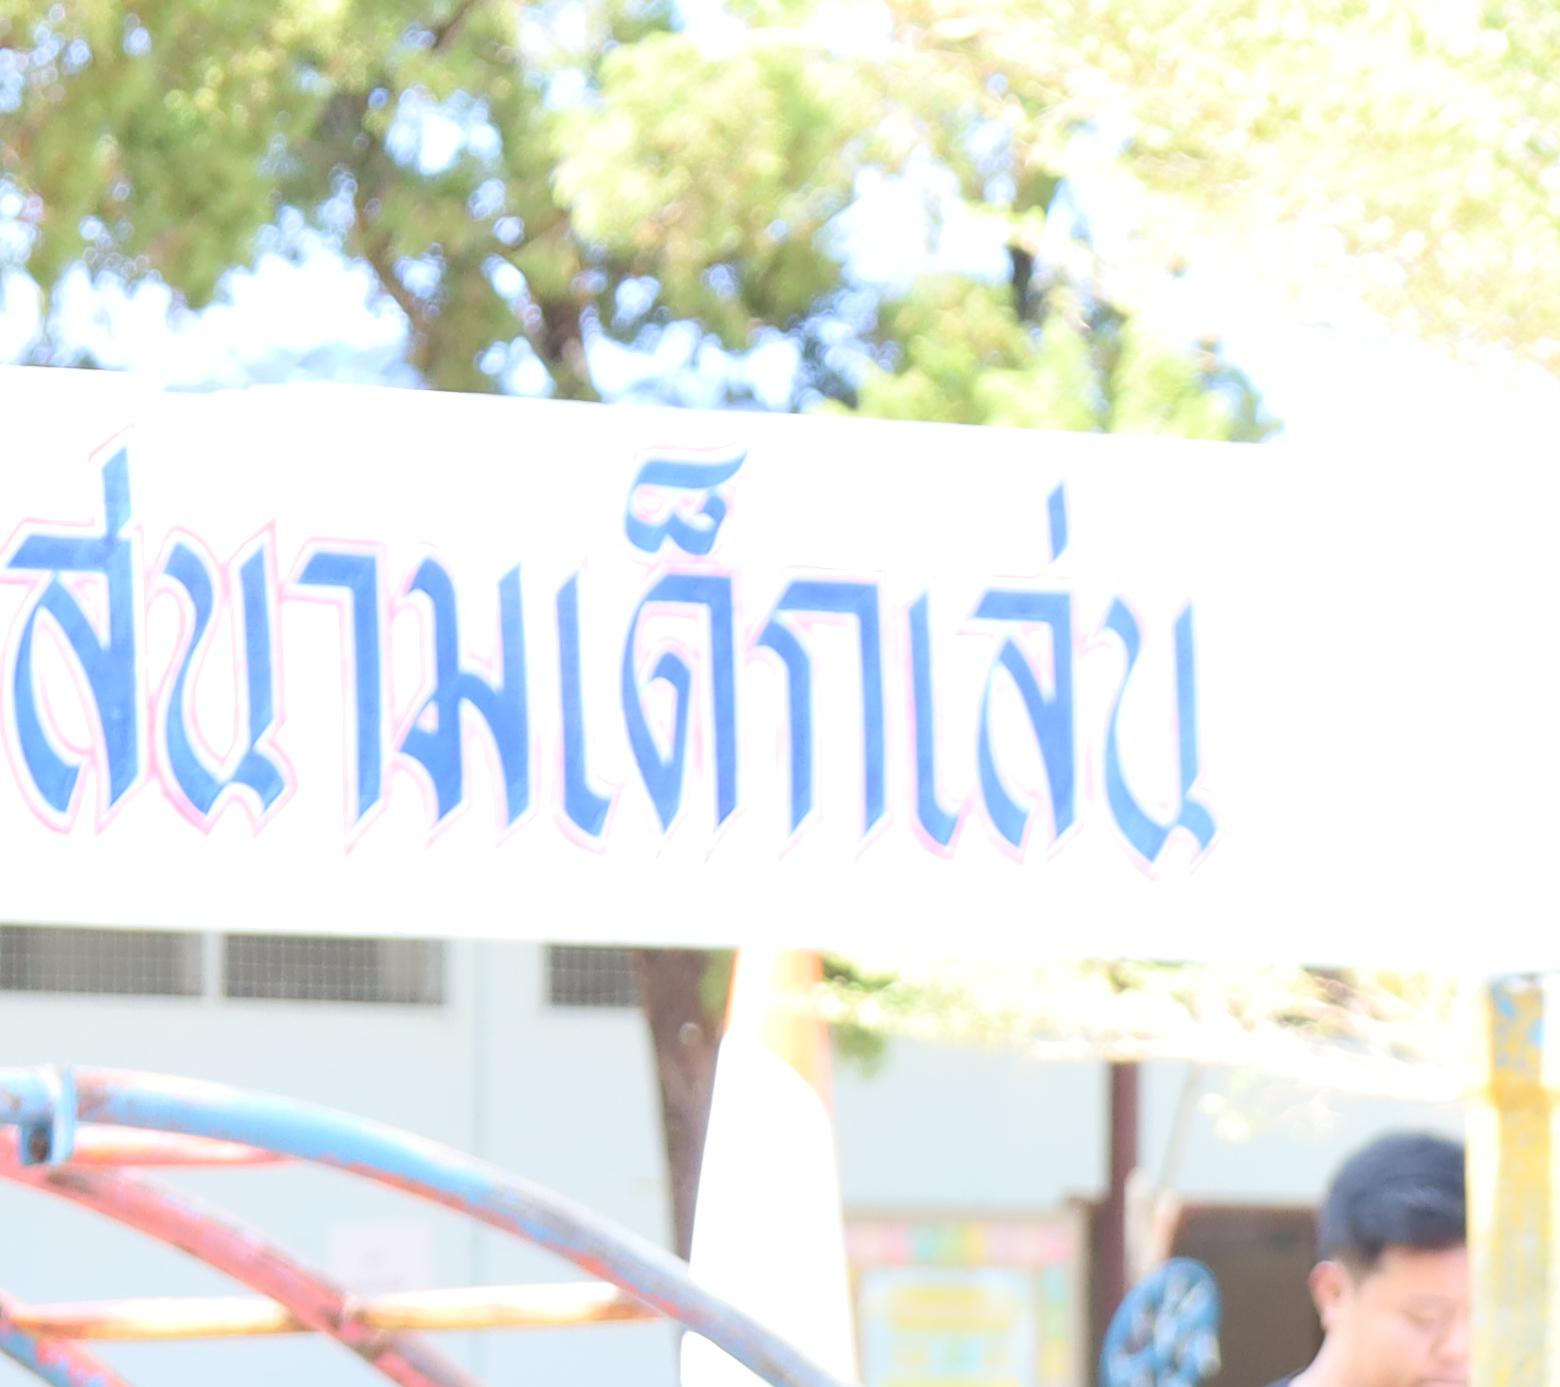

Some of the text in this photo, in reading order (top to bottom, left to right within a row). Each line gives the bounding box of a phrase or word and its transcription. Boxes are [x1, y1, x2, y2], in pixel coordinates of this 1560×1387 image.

[4, 442, 1222, 868] สนามเด็กเล่น
